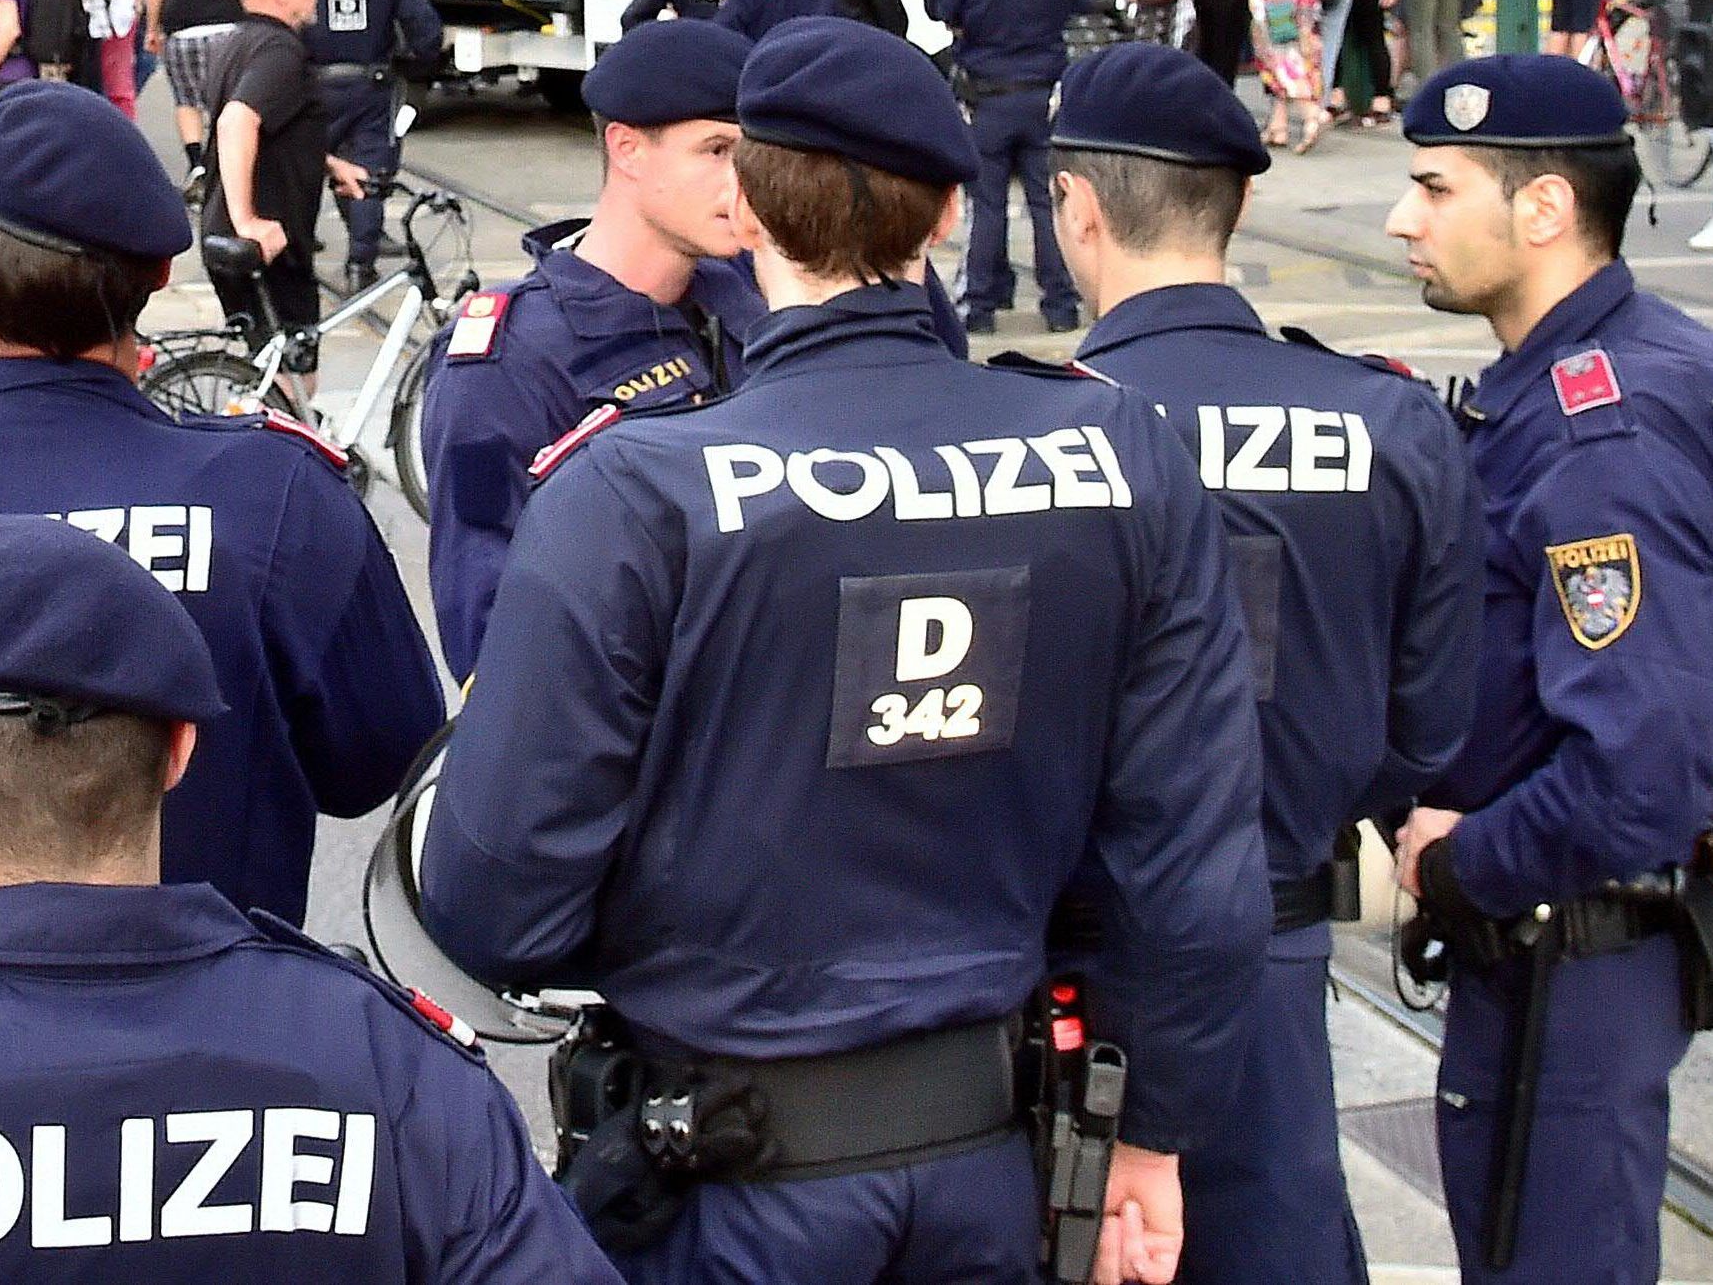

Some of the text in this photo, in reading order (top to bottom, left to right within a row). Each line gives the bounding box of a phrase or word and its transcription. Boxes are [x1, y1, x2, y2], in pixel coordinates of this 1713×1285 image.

[702, 425, 1133, 533] POLIZEI
[1155, 404, 1373, 492] IZEI
[895, 596, 973, 682] D
[866, 684, 983, 746] 342
